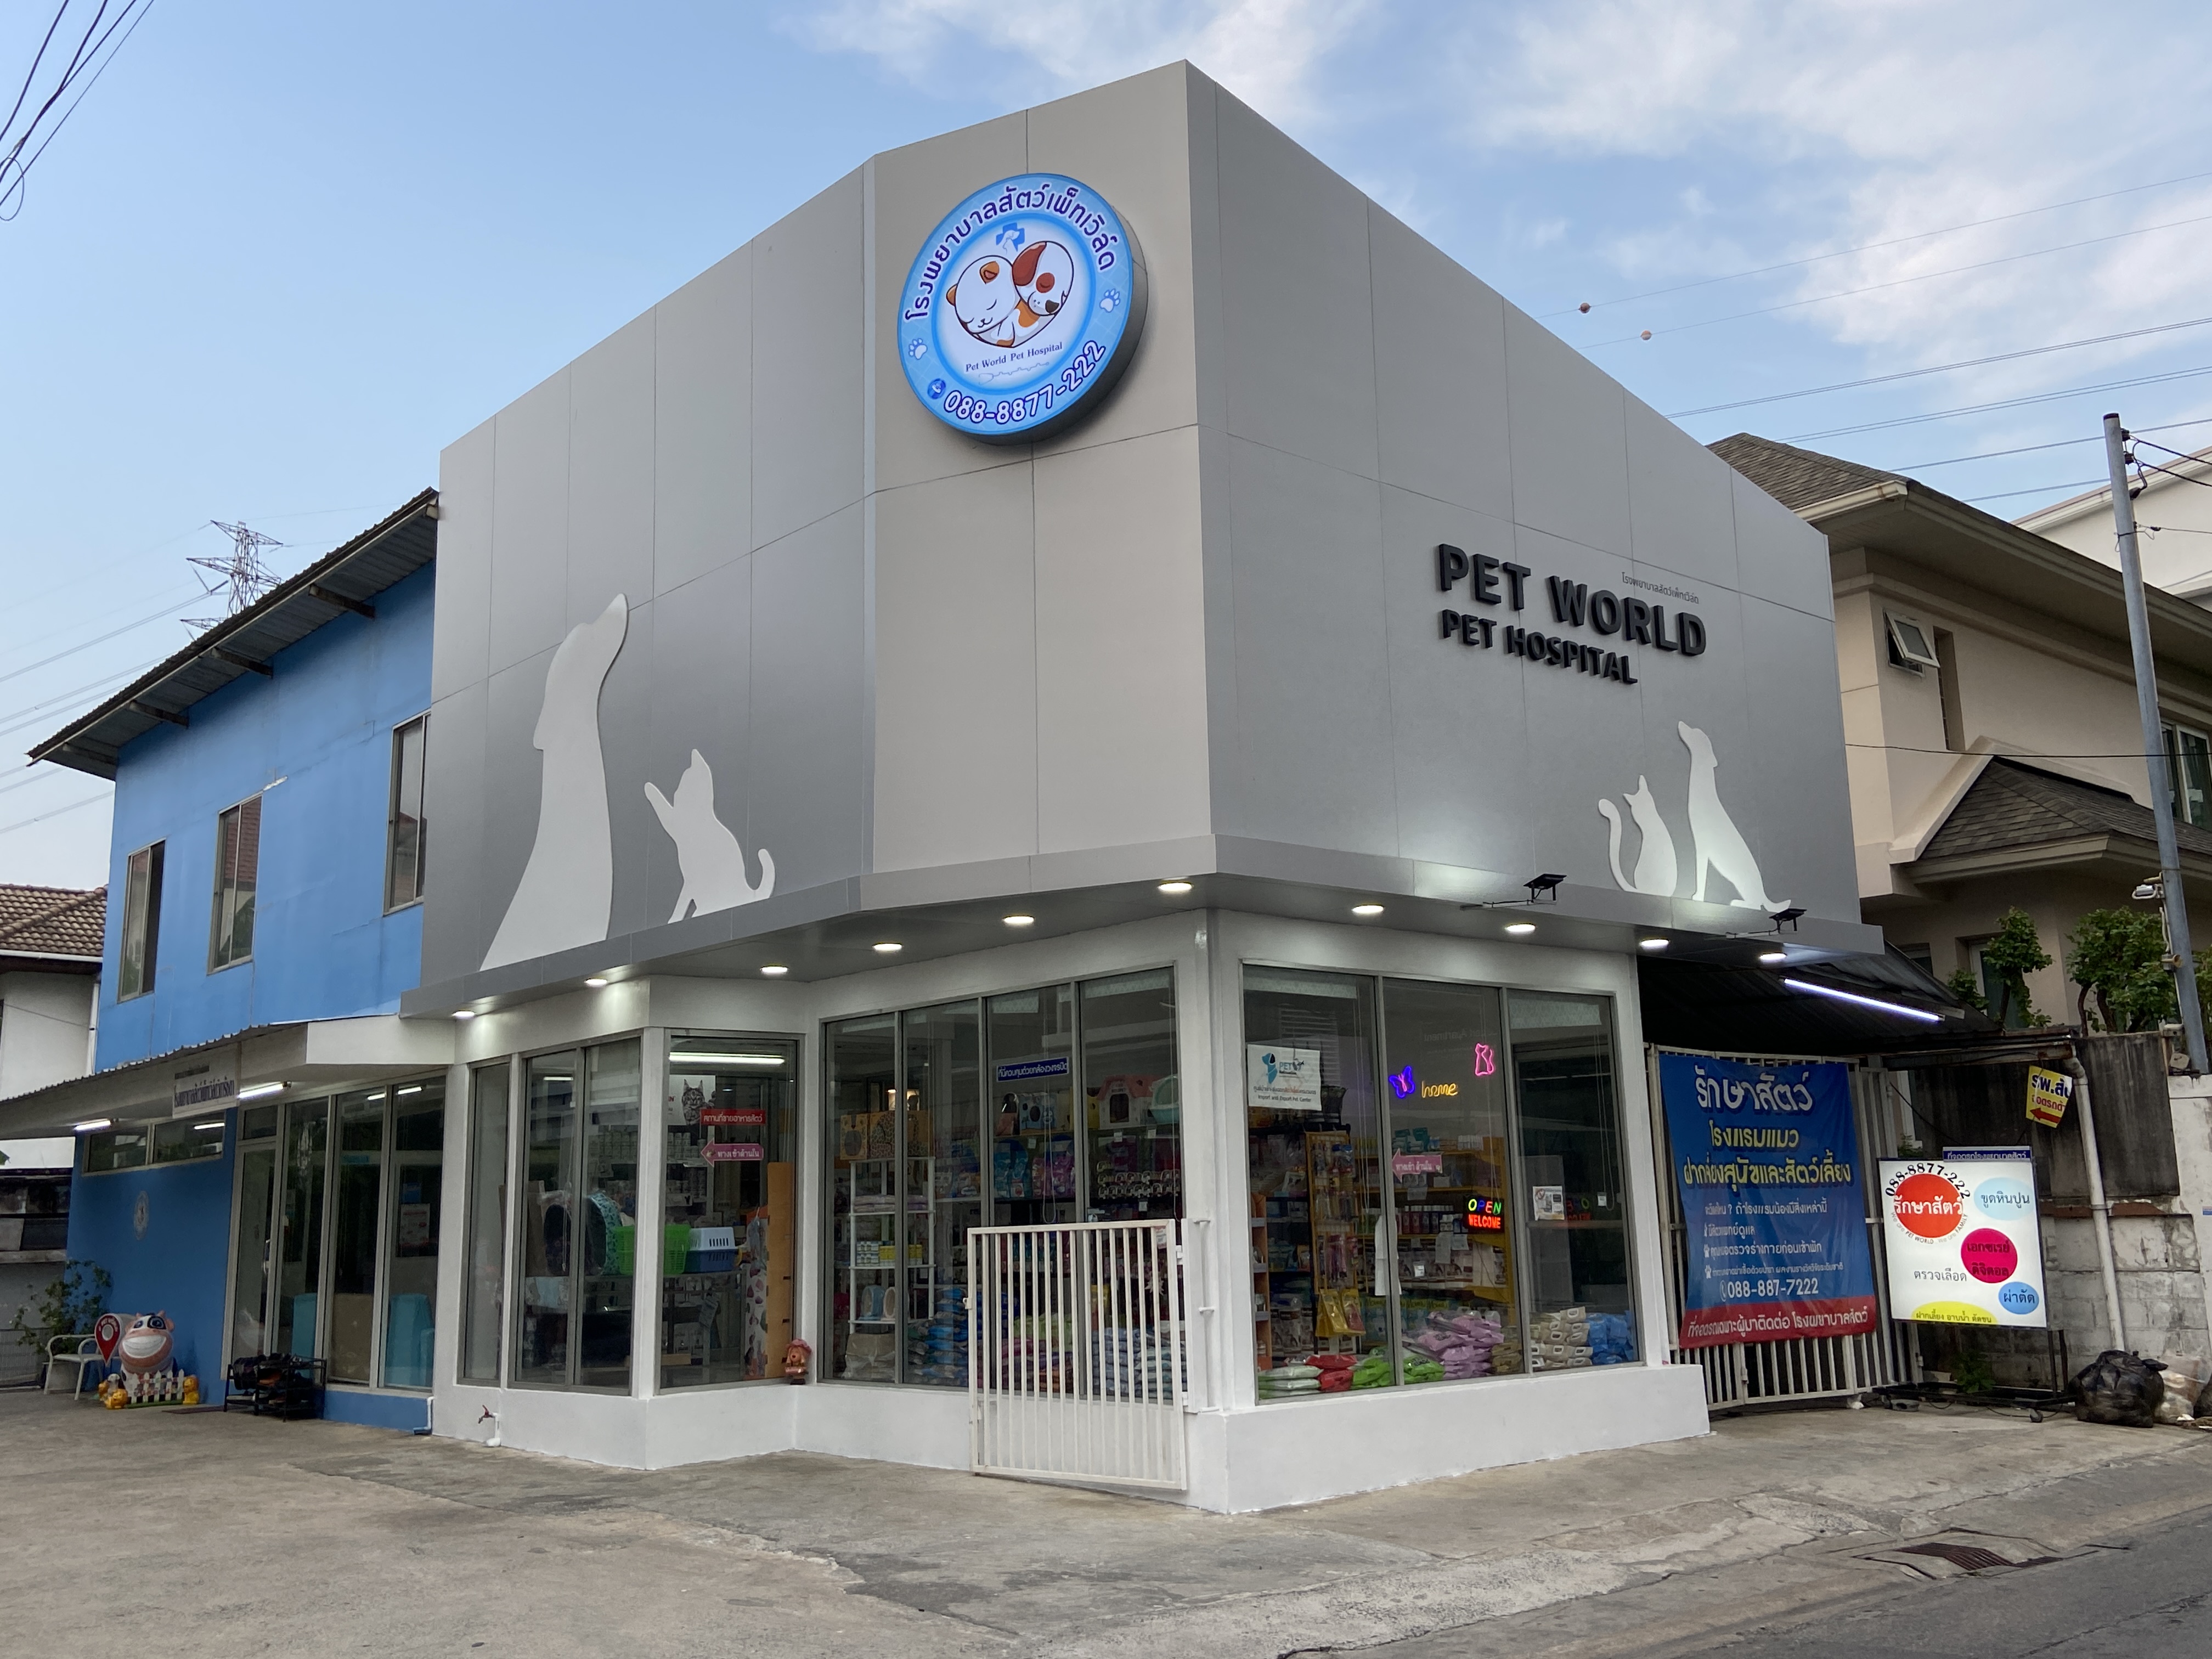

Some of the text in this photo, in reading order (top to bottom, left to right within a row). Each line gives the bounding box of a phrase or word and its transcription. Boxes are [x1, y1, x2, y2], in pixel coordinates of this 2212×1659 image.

[966, 342, 1063, 372] Pet World Pet Hospital
[944, 340, 1106, 424] 088-8877-222
[1438, 543, 1706, 656] PET WORLD
[1442, 608, 1638, 684] PET HOSPITAL
[1421, 1081, 1458, 1098] home
[1695, 1065, 1813, 1111] รักษาสัตว์
[703, 1111, 763, 1123] สถานที่ขายอาหารสัตว์
[1709, 1120, 1799, 1147] โรงแรมแมว
[1885, 1163, 1971, 1199] 088-8877-222
[1468, 1198, 1502, 1215] OPEN
[1894, 1195, 1964, 1215] รักษาสัตว์
[1981, 1190, 2030, 1209] ขูดหินปูน
[1469, 1214, 1501, 1229] WELCOME
[1955, 1213, 1968, 1233] FAMILY
[1914, 1267, 1967, 1282] ตรวจเลือด
[1728, 1278, 1818, 1299] 088-887-7222
[2003, 1289, 2035, 1305] ผ่าตัด
[1792, 1306, 1868, 1328] โรงพยาบาลสัตว์
[1916, 1308, 1944, 1320] ฝากเลี้ยง
[1947, 1311, 1970, 1322] อาบน้ำ
